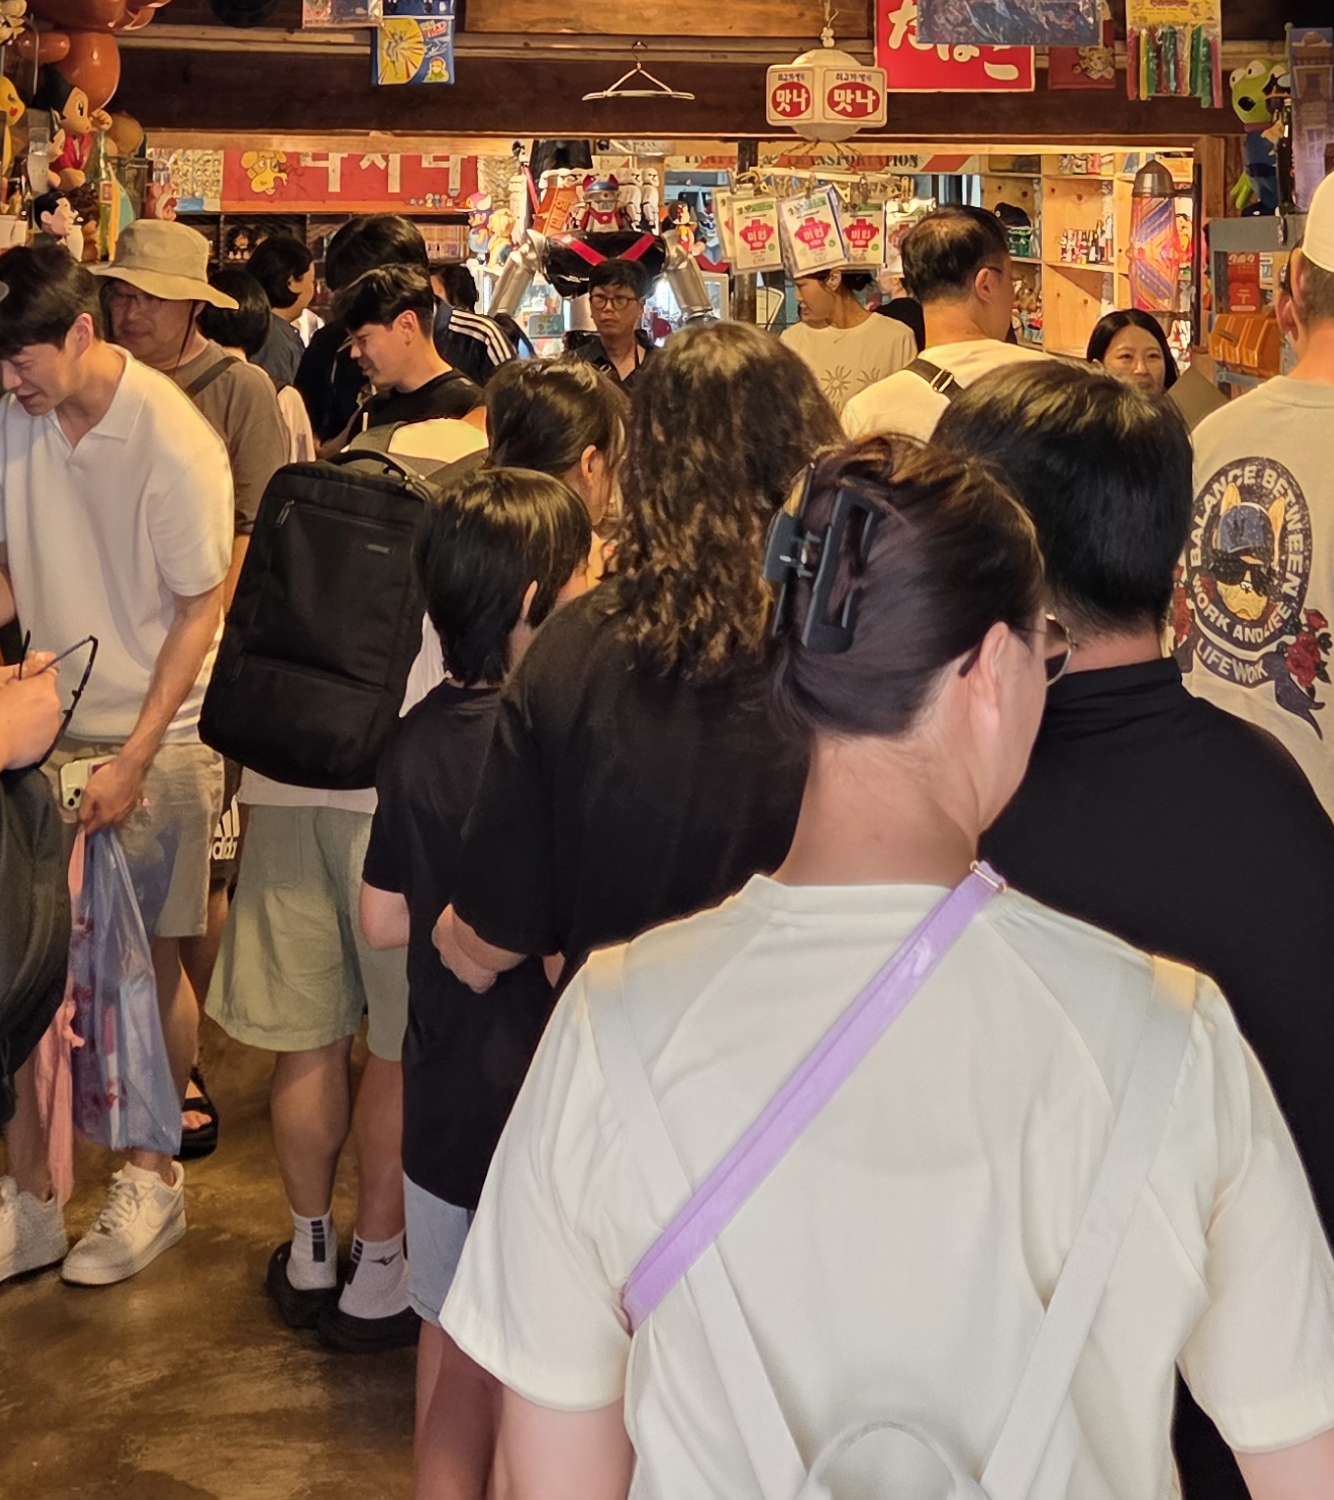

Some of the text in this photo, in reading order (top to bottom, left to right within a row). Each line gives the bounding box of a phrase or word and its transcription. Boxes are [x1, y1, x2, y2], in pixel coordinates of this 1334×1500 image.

[776, 88, 808, 112] 맛나
[833, 88, 876, 113] 맛나
[1190, 465, 1304, 597] BALANCE BETWEEN
[1192, 573, 1229, 633] WORK
[1232, 624, 1264, 644] AND
